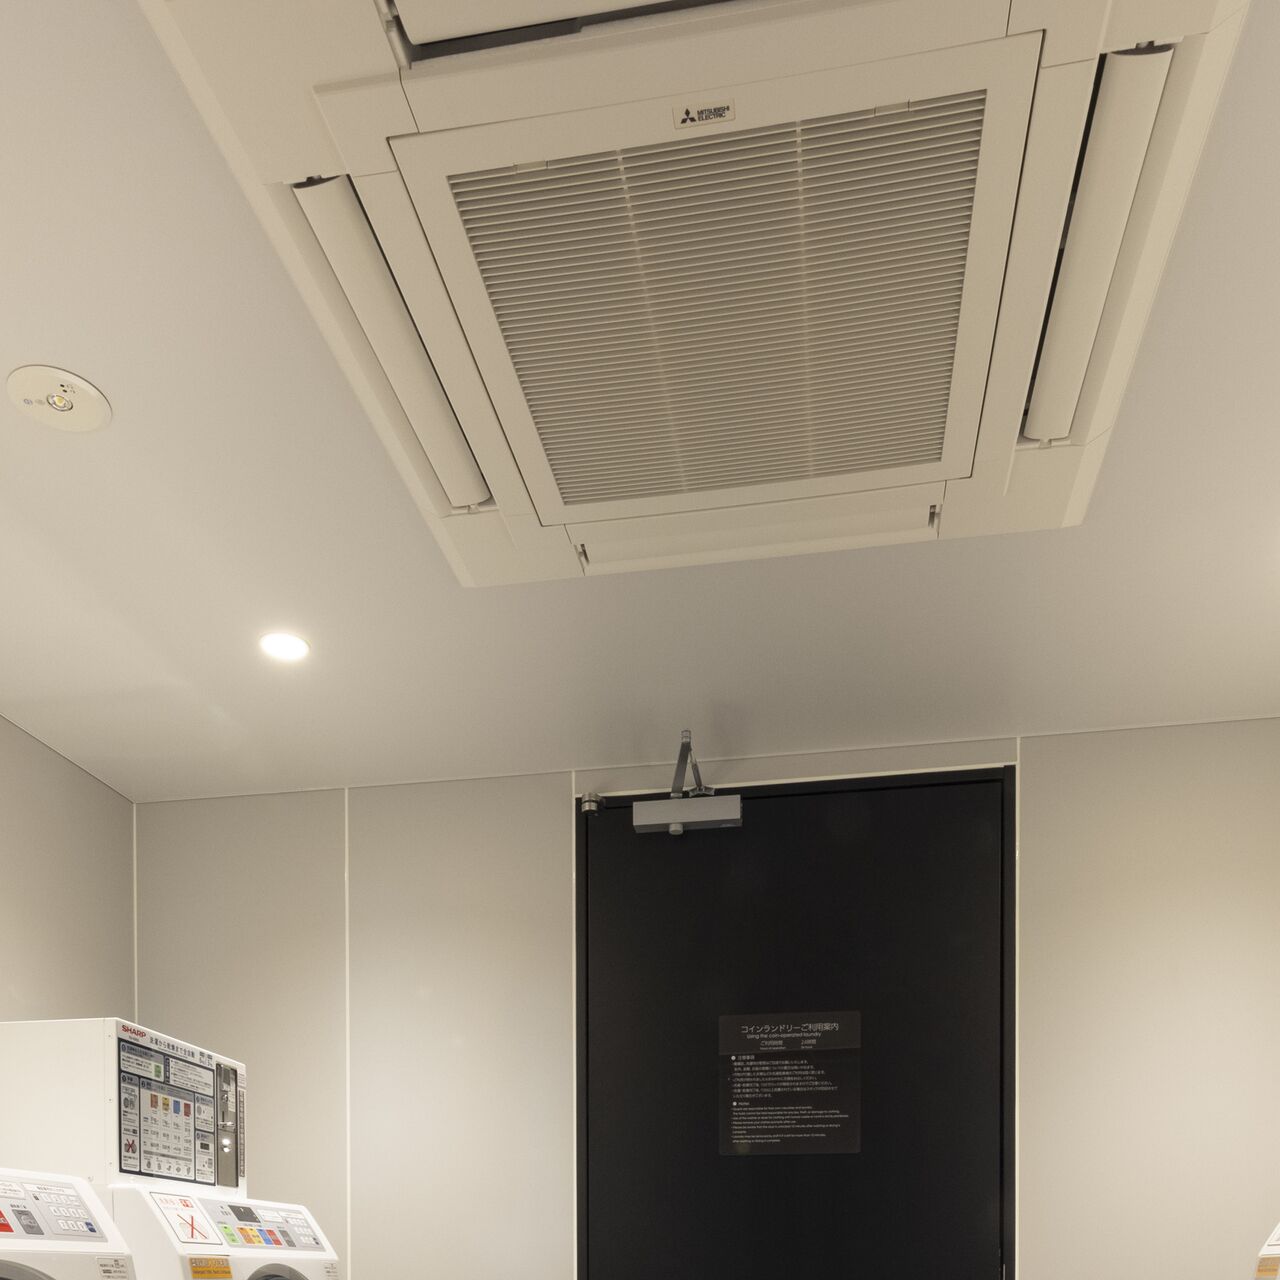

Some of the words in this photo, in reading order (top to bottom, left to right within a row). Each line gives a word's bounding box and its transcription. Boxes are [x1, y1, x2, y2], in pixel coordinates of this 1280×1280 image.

[697, 105, 730, 115] MITSUBISHI
[698, 111, 726, 121] ELECTRIC
[121, 1024, 147, 1038] SHARP
[741, 1023, 839, 1033] コインランドリーご利用案内
